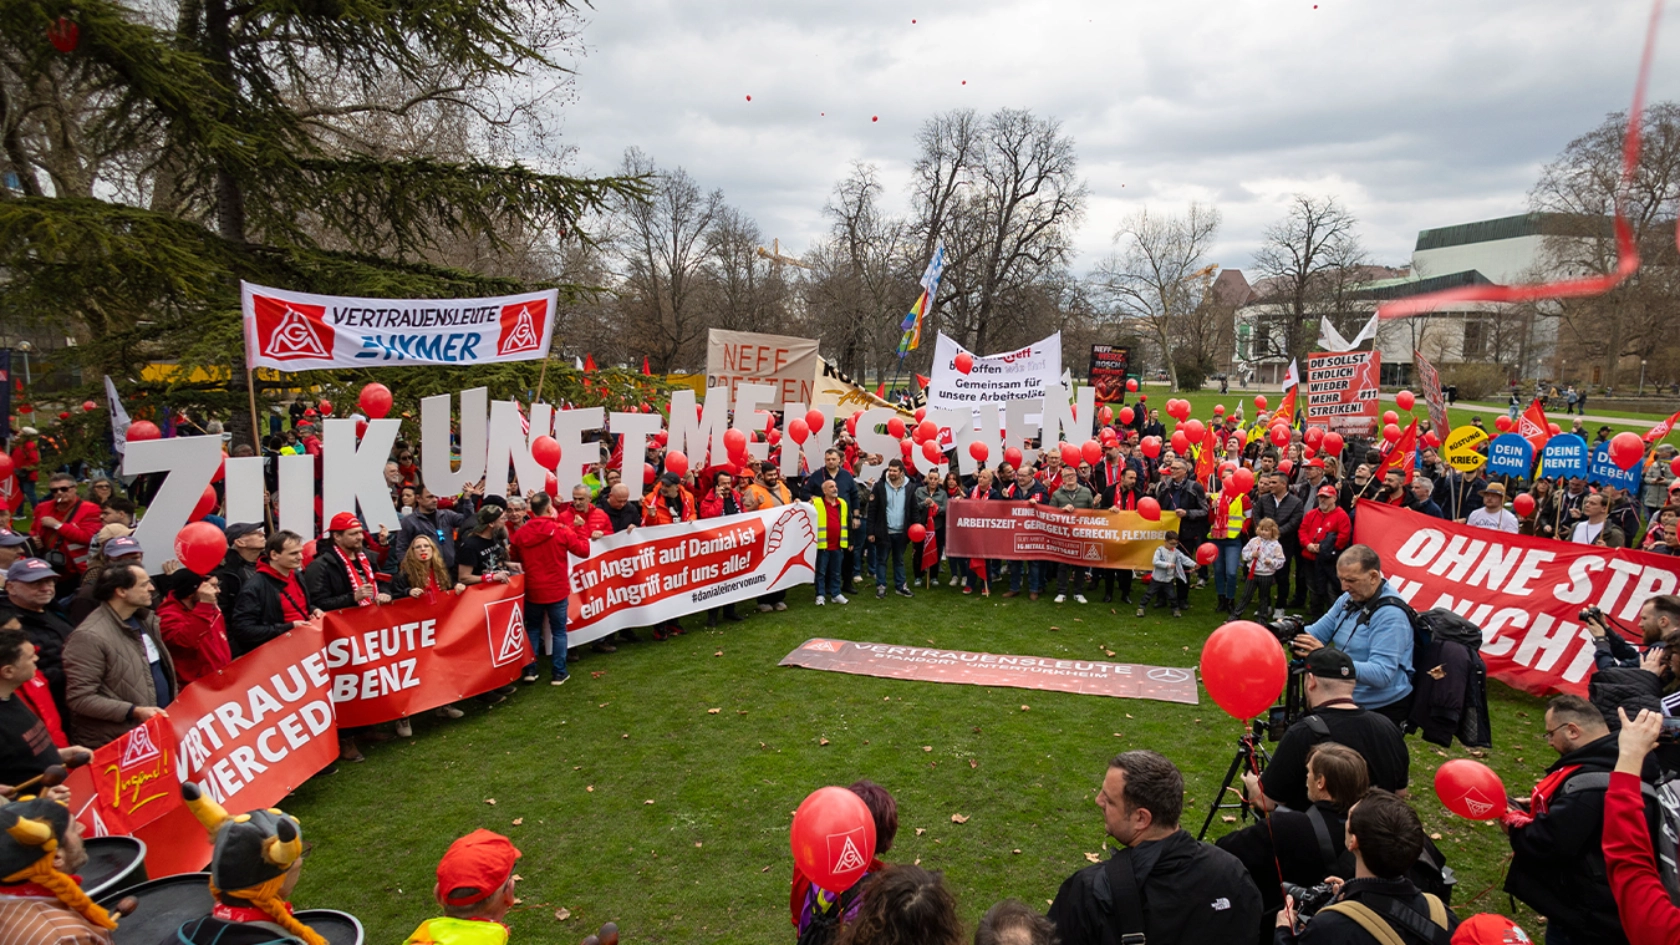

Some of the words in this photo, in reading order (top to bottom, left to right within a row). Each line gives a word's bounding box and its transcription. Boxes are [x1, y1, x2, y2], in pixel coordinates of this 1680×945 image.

[333, 306, 499, 328] VERTRAUENSLEUTE
[375, 332, 482, 362] HYMER
[724, 343, 789, 373] NEFF
[1310, 359, 1325, 369] DU
[1327, 353, 1366, 367] SOLLST
[949, 360, 1002, 374] boffen
[1311, 367, 1353, 380] ENDLICH
[955, 379, 1021, 390] Gemeinsam
[1024, 377, 1042, 388] für
[1310, 380, 1348, 392] WIEDER
[939, 390, 977, 401] unsere
[1311, 393, 1340, 404] MEHR
[1359, 390, 1377, 399] #11
[1310, 403, 1362, 417] STREIKEN!
[1495, 444, 1523, 456] DEIN
[1545, 446, 1581, 457] DEINE
[1450, 456, 1479, 464] KRIEG
[1492, 456, 1523, 468] LOHN
[1544, 458, 1581, 469] RENTE
[1592, 464, 1634, 482] LEBEN
[1012, 507, 1036, 517] KEINE
[957, 517, 1017, 529] ARBEITSZEIT
[1023, 519, 1070, 538] GEREGELT,
[1072, 528, 1120, 541] GERECHT,
[571, 567, 599, 593] Ein
[600, 546, 655, 579] Angriff
[659, 540, 687, 566] auf
[689, 531, 738, 558] Danial
[739, 527, 756, 546] ist
[1396, 528, 1556, 596] OHNE
[1553, 554, 1680, 622] STR
[580, 594, 605, 620] ein
[606, 576, 660, 604] Angriff
[663, 569, 690, 593] auf
[691, 563, 719, 583] uns
[721, 551, 752, 575] alle!
[691, 573, 766, 603] #danialeinervonuns
[855, 644, 1132, 674] VERTRAUENSLEUTE
[875, 653, 959, 666] STANDORT
